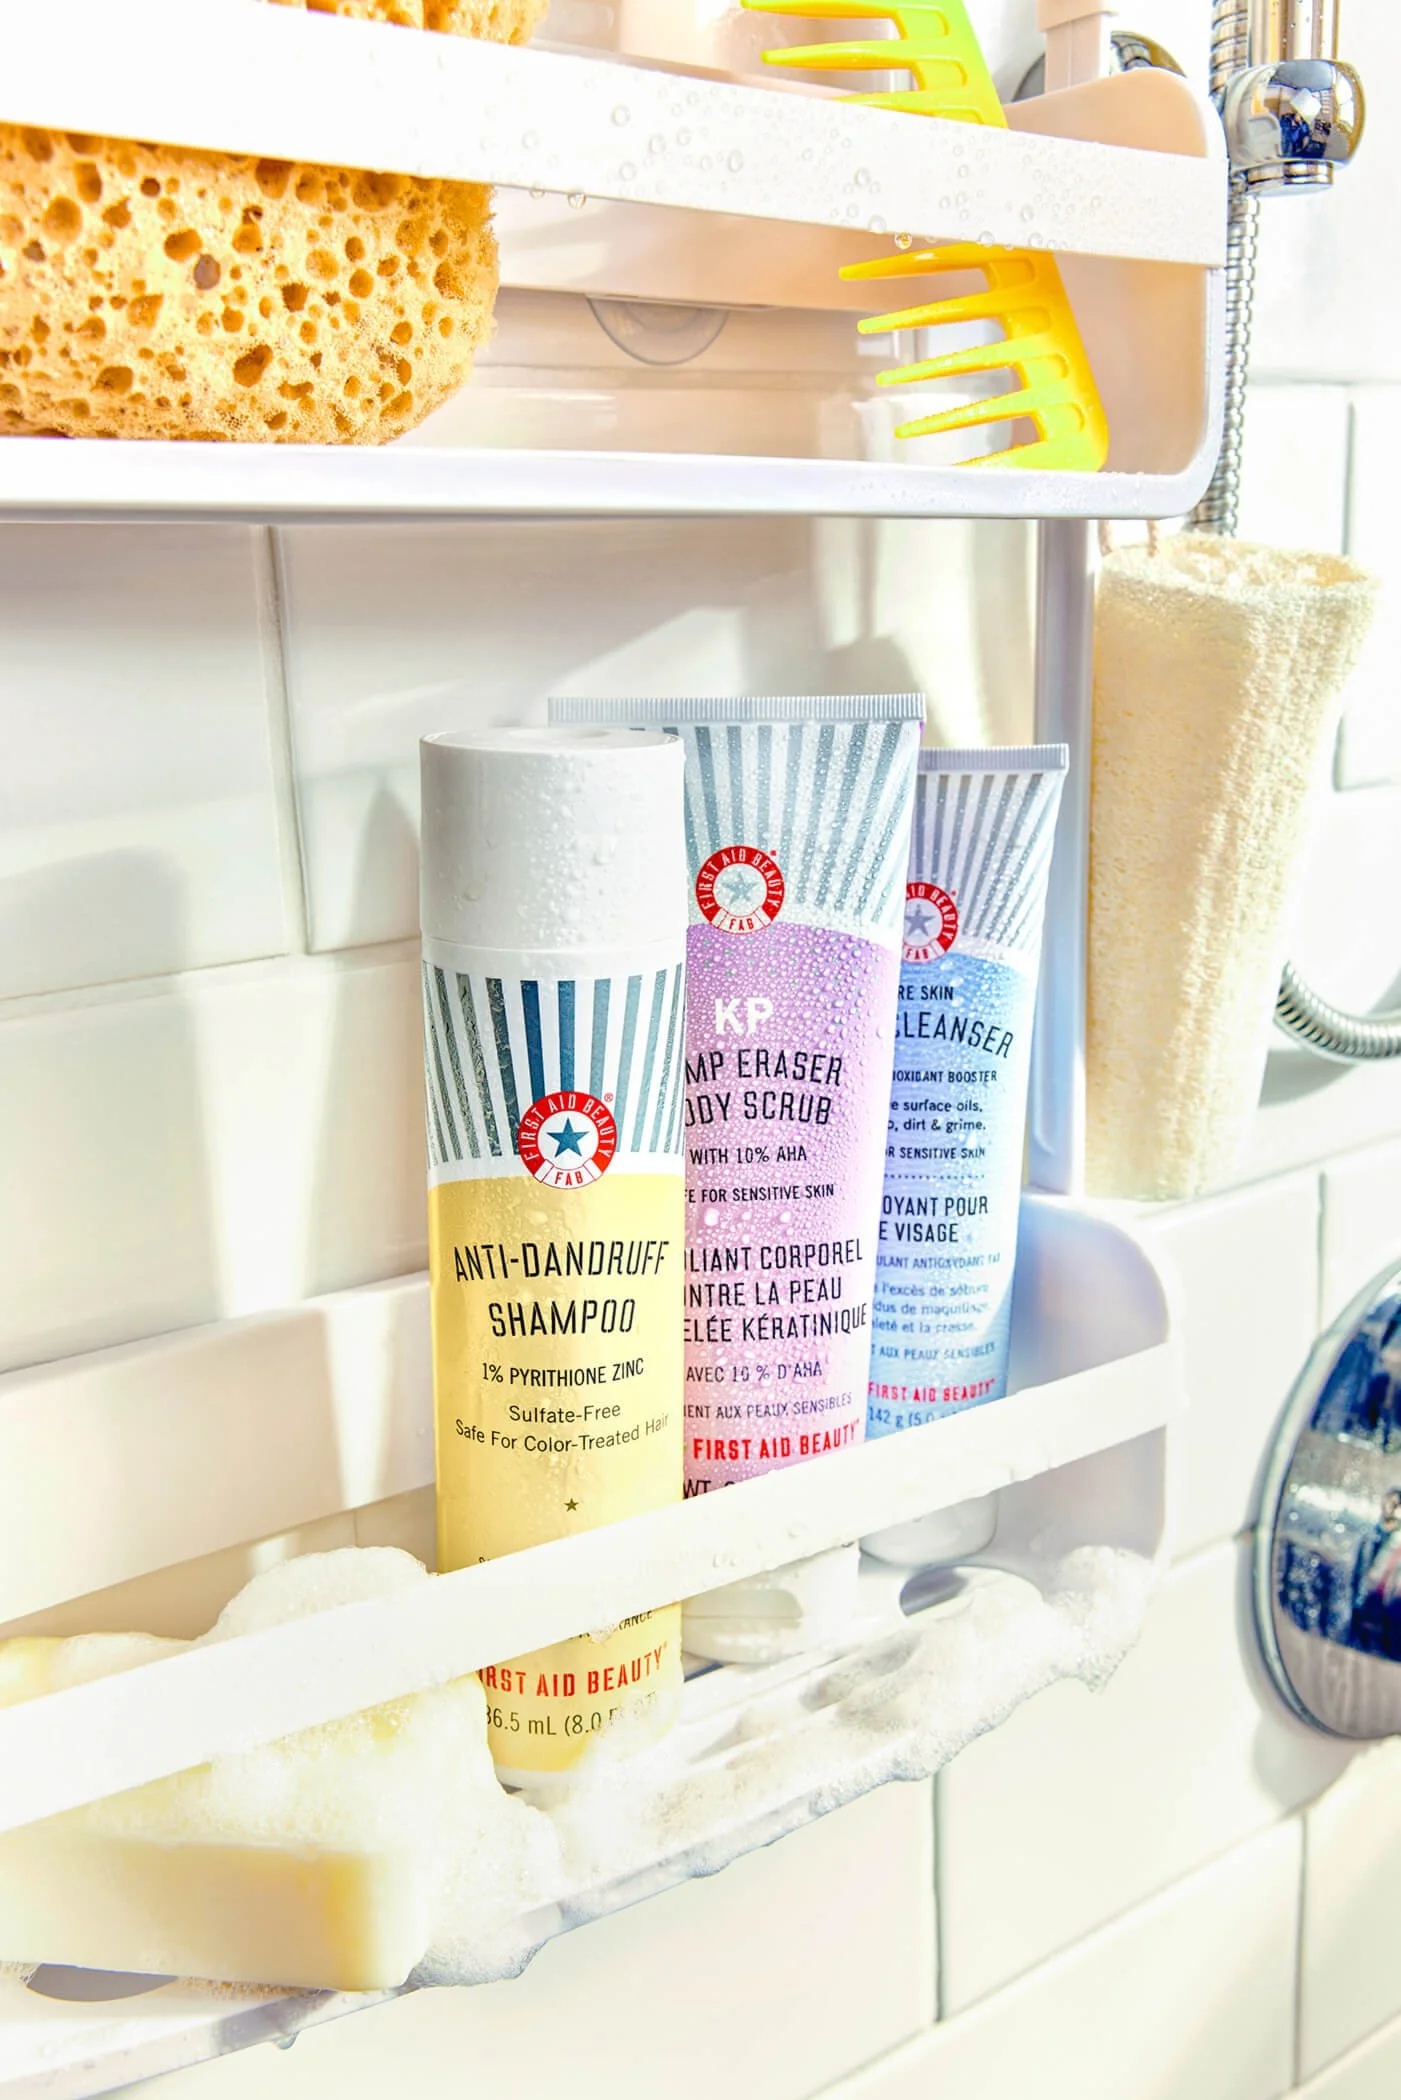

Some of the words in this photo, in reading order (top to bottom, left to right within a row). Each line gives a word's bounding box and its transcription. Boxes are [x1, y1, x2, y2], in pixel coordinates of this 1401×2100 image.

[698, 861, 719, 910] FIRST
[721, 848, 746, 866] AID
[752, 853, 783, 908] BEAUTY
[729, 918, 754, 931] FAB
[920, 985, 954, 1001] SKIN
[715, 996, 774, 1035] KP
[738, 1049, 843, 1087] ERASER
[948, 1070, 998, 1083] BOOSTER
[744, 1091, 832, 1125] SCRUB
[903, 1099, 952, 1112] surface
[520, 1108, 545, 1161] FIRST
[548, 1094, 577, 1112] AID
[583, 1098, 615, 1159] BEAUTY
[903, 1118, 926, 1131] dirt
[931, 1119, 941, 1130] &
[946, 1118, 986, 1133] grime.
[690, 1147, 729, 1165] WITH
[737, 1146, 770, 1164] 10%
[777, 1145, 807, 1162] AHA
[900, 1147, 957, 1159] SENSITIVE
[961, 1147, 985, 1159] SKIN
[555, 1171, 584, 1186] FAB
[702, 1188, 727, 1203] FOR
[732, 1184, 800, 1202] SENSITIVE
[805, 1184, 835, 1199] SKIN
[945, 1195, 988, 1216] POUR
[895, 1222, 959, 1242] VISAGE
[454, 1240, 669, 1282] ANTI-DANDRUFF
[760, 1238, 862, 1270] CORPOREL
[755, 1280, 780, 1305] LA
[790, 1276, 842, 1305] PEAU
[929, 1284, 945, 1297] de
[488, 1298, 636, 1337] SHAMPOO
[901, 1303, 917, 1315] de
[743, 1303, 867, 1341] KÉRATINIQUE
[902, 1321, 914, 1333] et
[919, 1321, 931, 1333] la
[879, 1345, 898, 1358] AUX
[904, 1347, 938, 1361] PEAUX
[482, 1363, 504, 1383] 1%
[510, 1366, 607, 1387] PYRITHIONE
[612, 1358, 644, 1382] ZINC
[686, 1365, 724, 1383] AVEC
[756, 1364, 771, 1382] %
[777, 1361, 823, 1380] D'AHA
[868, 1381, 907, 1401] FIRST
[913, 1387, 937, 1402] AID
[509, 1403, 621, 1423] Sulfate-Free
[716, 1404, 742, 1419] AUX
[747, 1402, 789, 1418] PEAUX
[793, 1392, 852, 1415] SENSIBLES
[868, 1406, 890, 1424] 142
[455, 1419, 485, 1443] Safe
[491, 1431, 517, 1449] For
[524, 1425, 640, 1452] Color-Treated
[645, 1413, 668, 1436] Hair
[693, 1438, 752, 1461] FIRST
[759, 1436, 791, 1459] AID
[536, 1673, 576, 1697] AID
[528, 1715, 557, 1736] mL
[564, 1711, 601, 1737] (8.0
